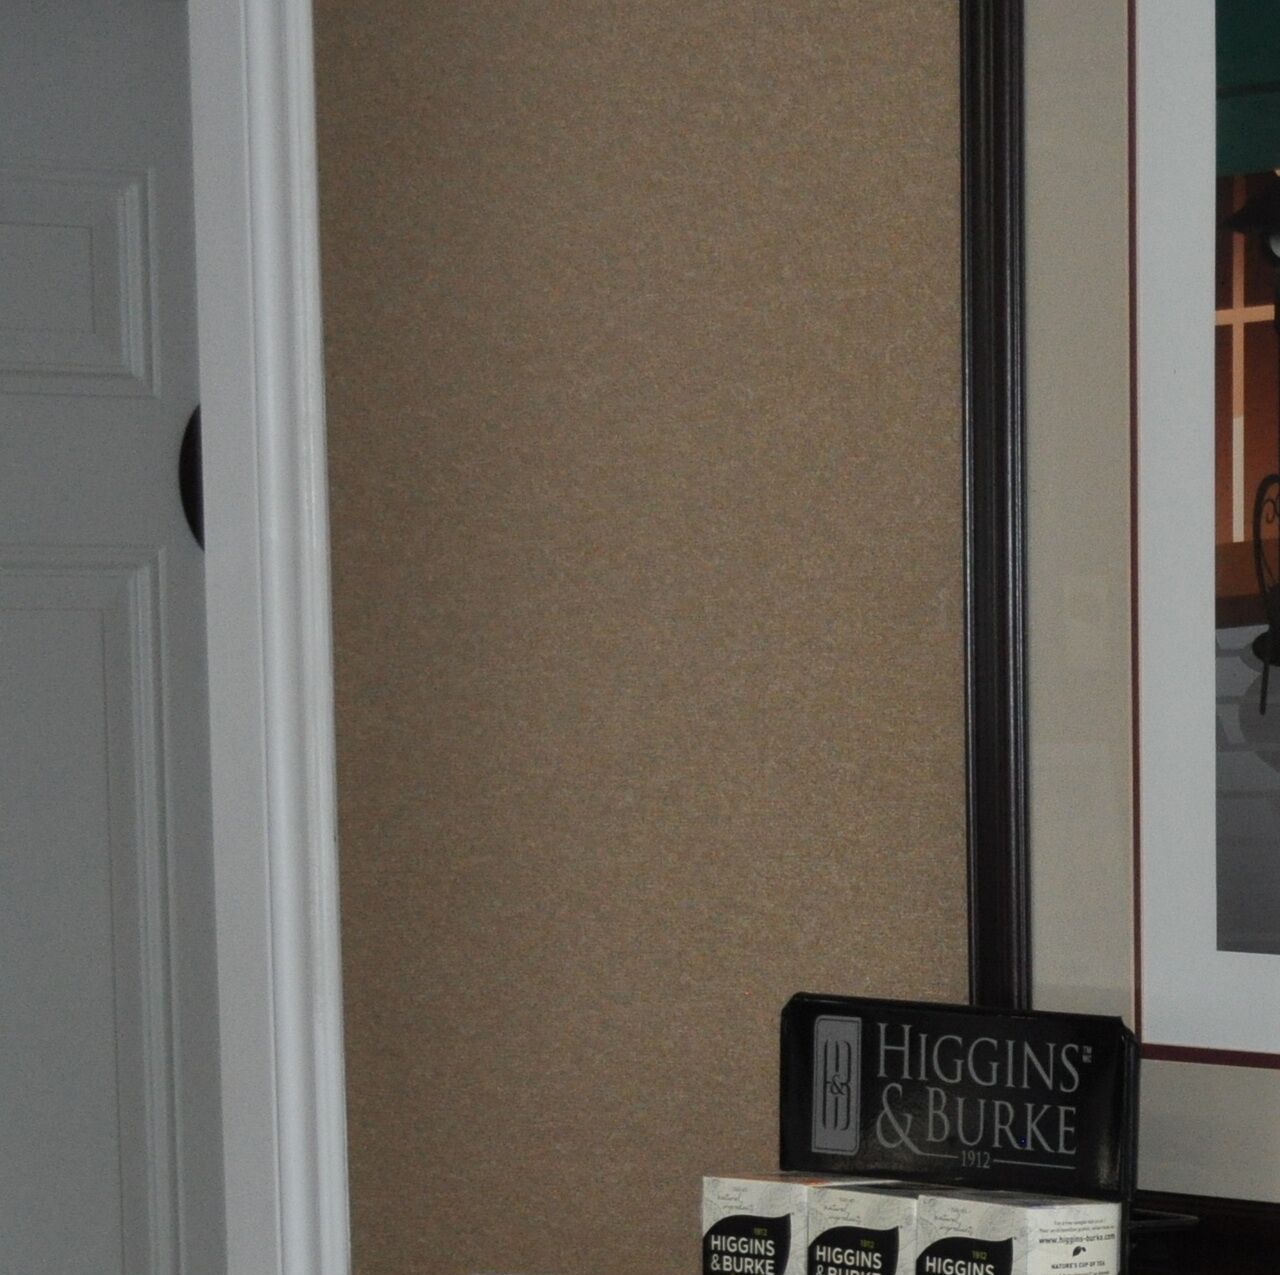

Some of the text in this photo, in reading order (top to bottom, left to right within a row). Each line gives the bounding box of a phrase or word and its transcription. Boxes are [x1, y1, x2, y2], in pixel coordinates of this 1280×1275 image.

[877, 1022, 1080, 1094] HIGGINS
[962, 1150, 991, 1169] 1912
[711, 1234, 775, 1256] HIGGINS
[816, 1245, 882, 1269] HIGGINS
